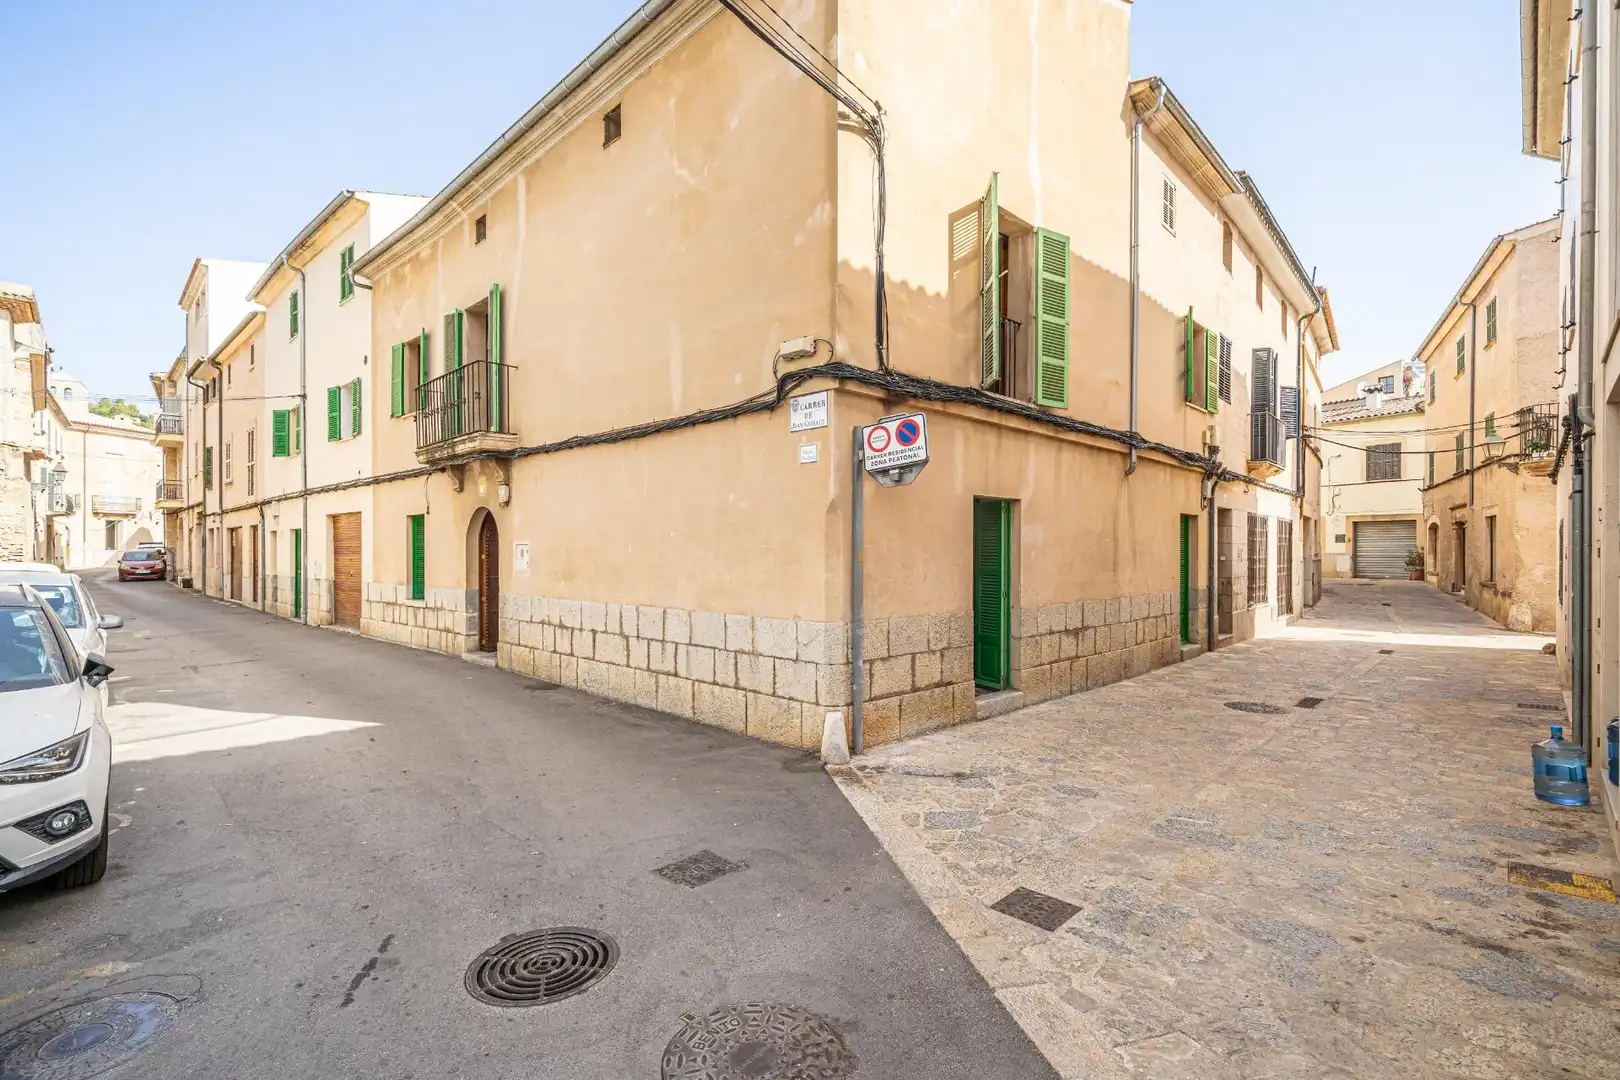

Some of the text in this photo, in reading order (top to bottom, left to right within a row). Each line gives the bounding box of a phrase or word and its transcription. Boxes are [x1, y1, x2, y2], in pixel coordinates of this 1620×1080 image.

[800, 400, 826, 411] CARRER
[804, 411, 813, 420] DE
[866, 446, 925, 461] CARRER RESIDENCIAL
[871, 452, 921, 467] ZONA PEATONAL
[692, 1018, 740, 1050] BENITO
